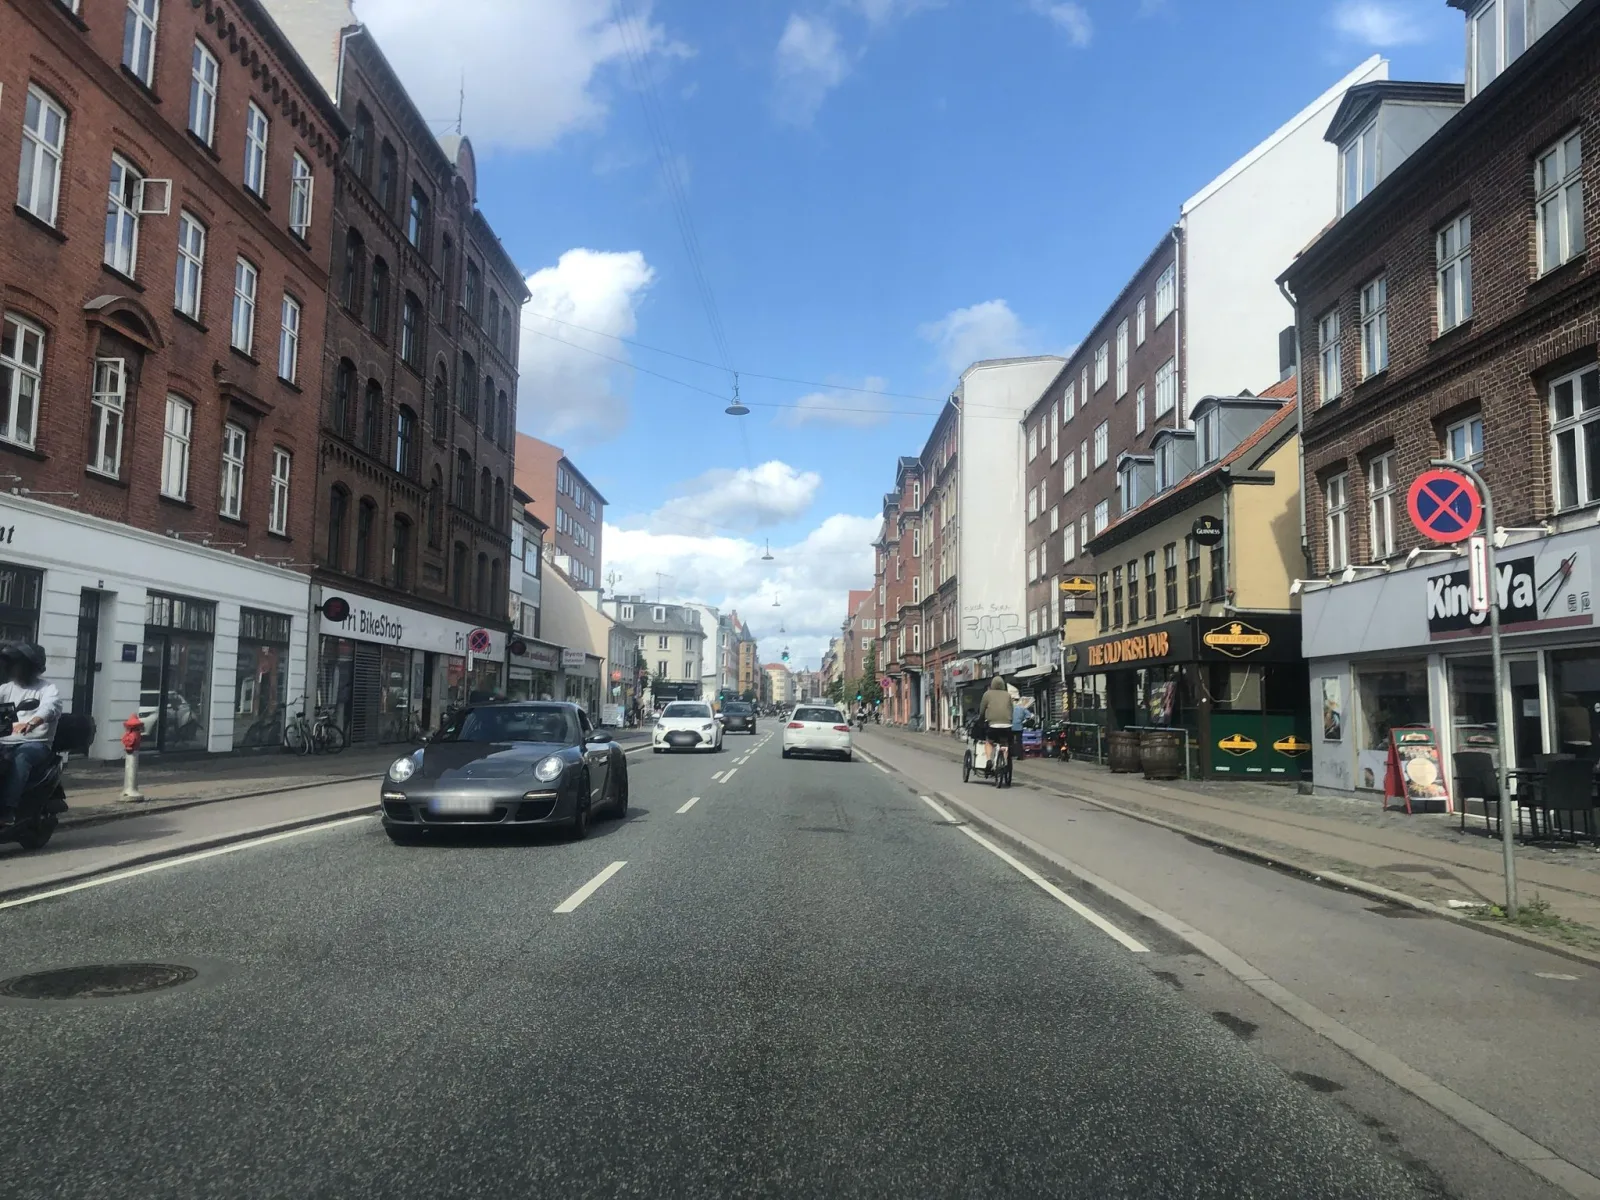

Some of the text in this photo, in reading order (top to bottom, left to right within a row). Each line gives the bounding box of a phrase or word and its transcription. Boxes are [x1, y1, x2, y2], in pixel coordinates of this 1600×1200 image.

[1496, 564, 1534, 609] Ya
[360, 610, 403, 645] BikeShop
[455, 631, 465, 651] Fri
[1088, 631, 1169, 667] THE OLD IRISH PUB
